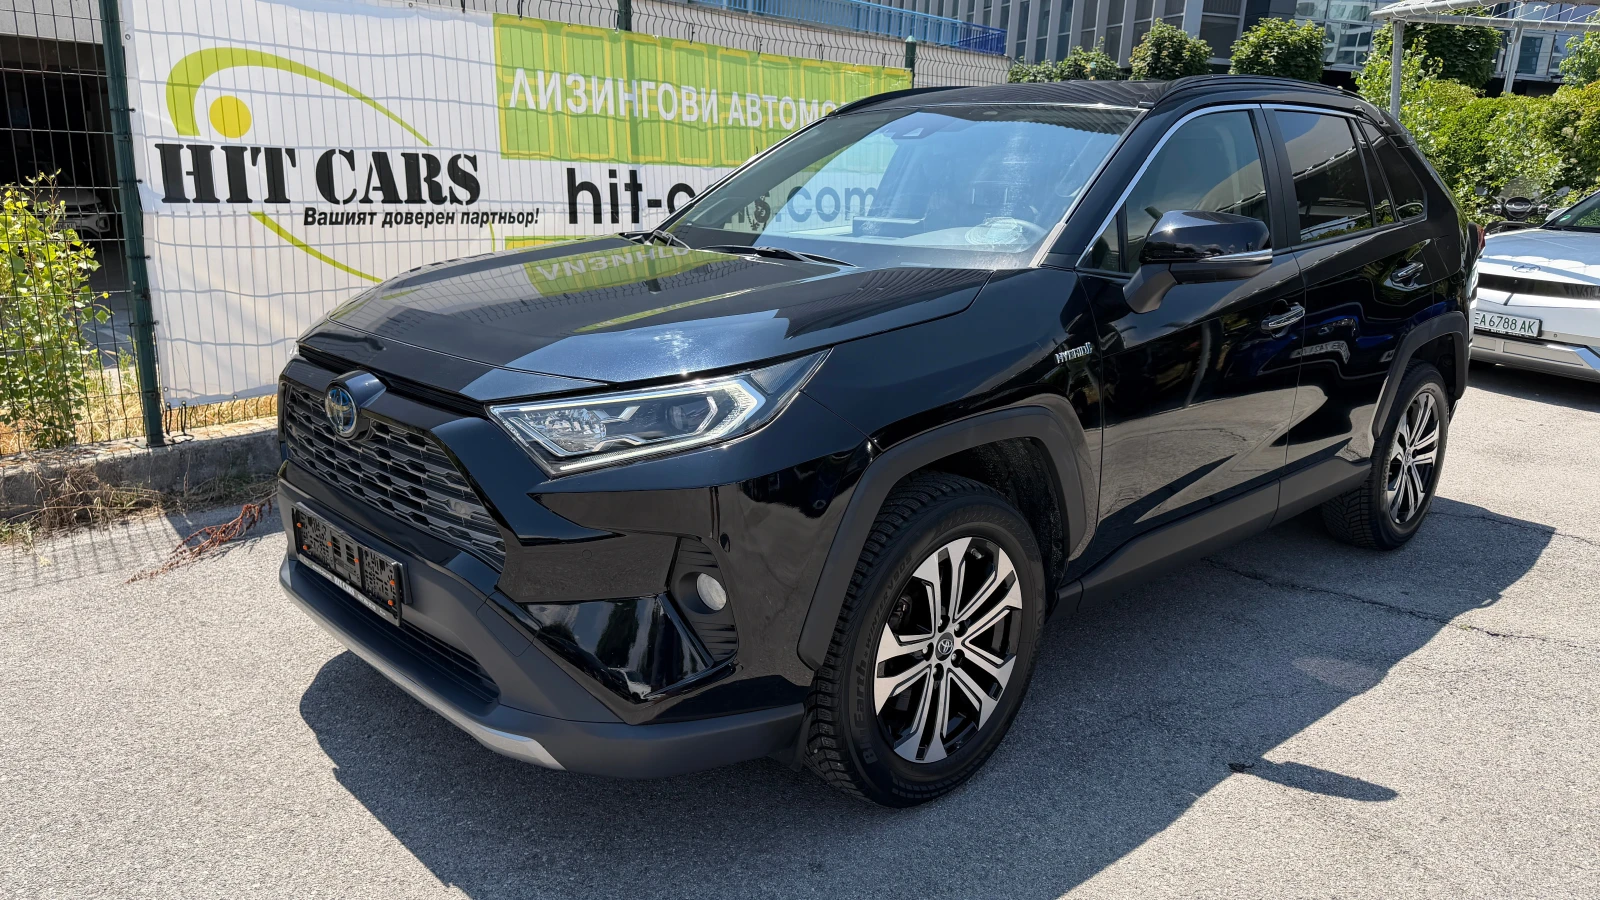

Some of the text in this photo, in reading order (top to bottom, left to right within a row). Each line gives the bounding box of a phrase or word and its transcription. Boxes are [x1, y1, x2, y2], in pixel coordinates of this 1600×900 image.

[509, 68, 849, 130] ЛИЗИНГОВИ АВТОМ
[155, 143, 482, 205] HIT CARS
[303, 207, 540, 228] Вашият доверен партньор!
[1488, 315, 1518, 331] 6788
[1519, 320, 1536, 334] AK
